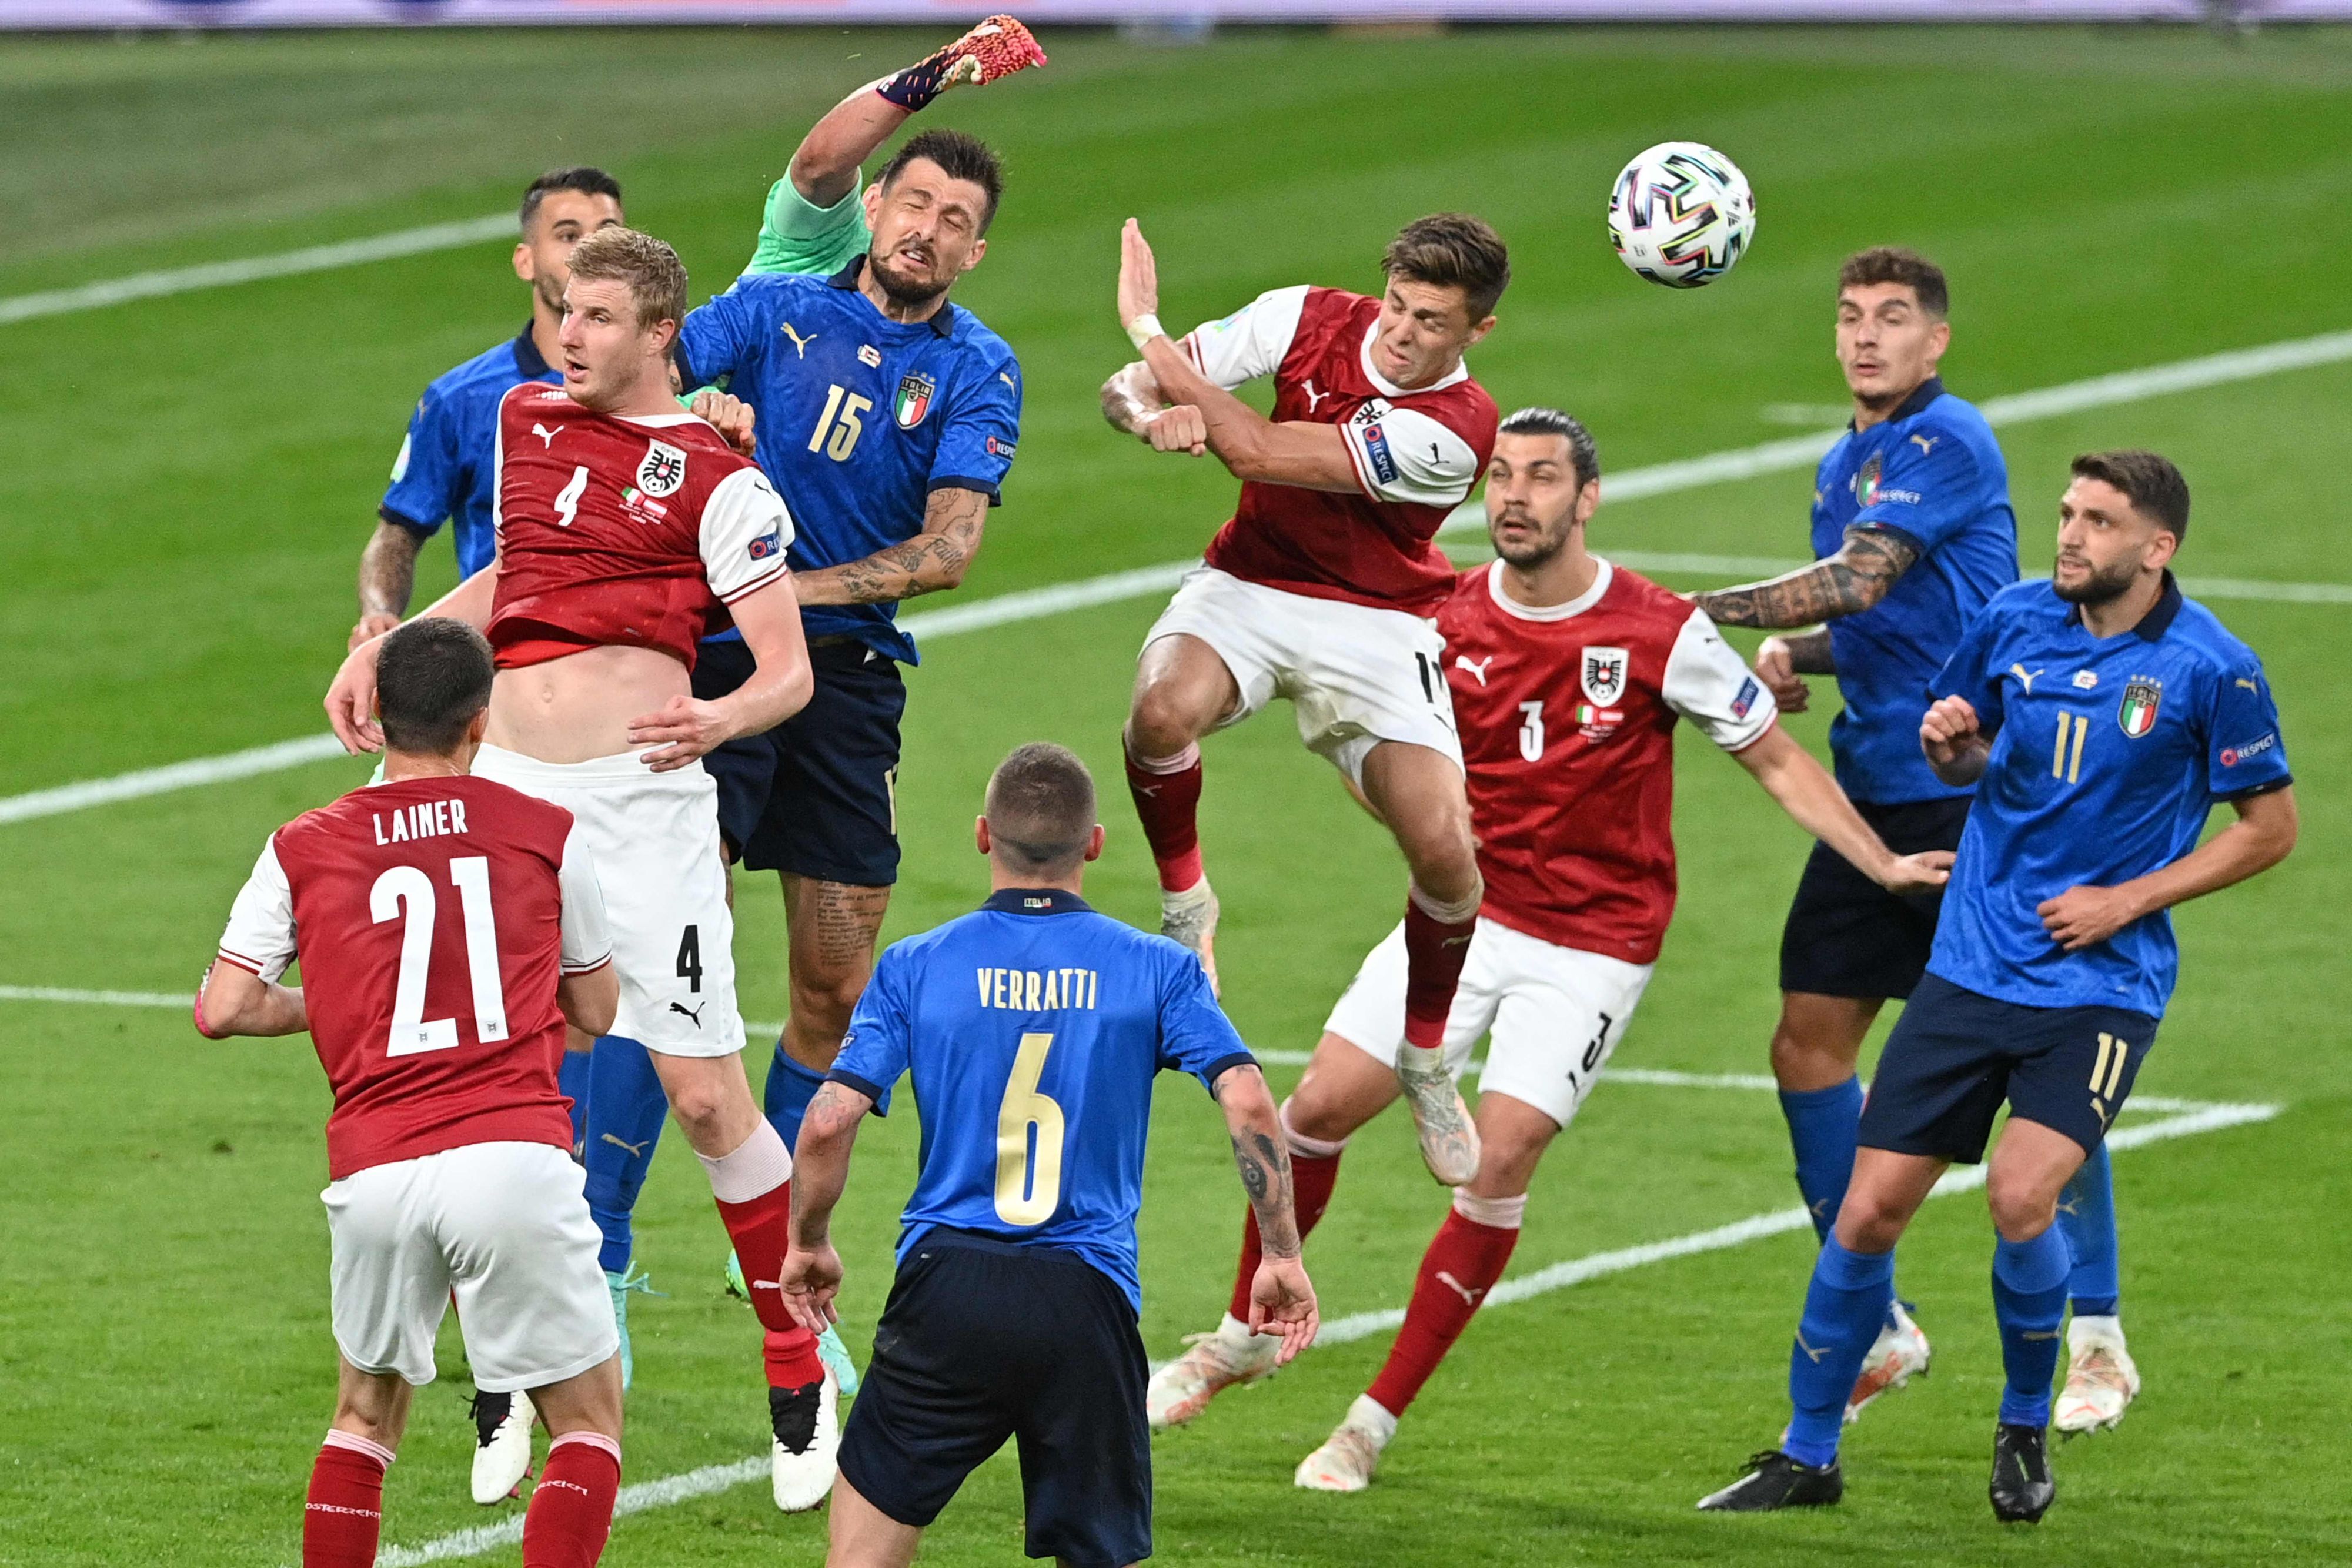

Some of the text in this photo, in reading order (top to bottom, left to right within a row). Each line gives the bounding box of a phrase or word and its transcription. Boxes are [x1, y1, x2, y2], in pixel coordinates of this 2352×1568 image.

[901, 379, 931, 395] ITALIA
[808, 384, 873, 462] 15
[554, 466, 590, 527] 4
[1519, 700, 1545, 763] 3
[2052, 710, 2088, 784] 11
[373, 799, 469, 846] LAINER
[884, 764, 898, 835] 1
[369, 856, 509, 1057] 21
[676, 924, 703, 993] 4
[977, 968, 1097, 1011] VERRATTI
[1582, 1011, 1612, 1072] 3
[2088, 1032, 2128, 1102] 11
[994, 1033, 1064, 1226] 6
